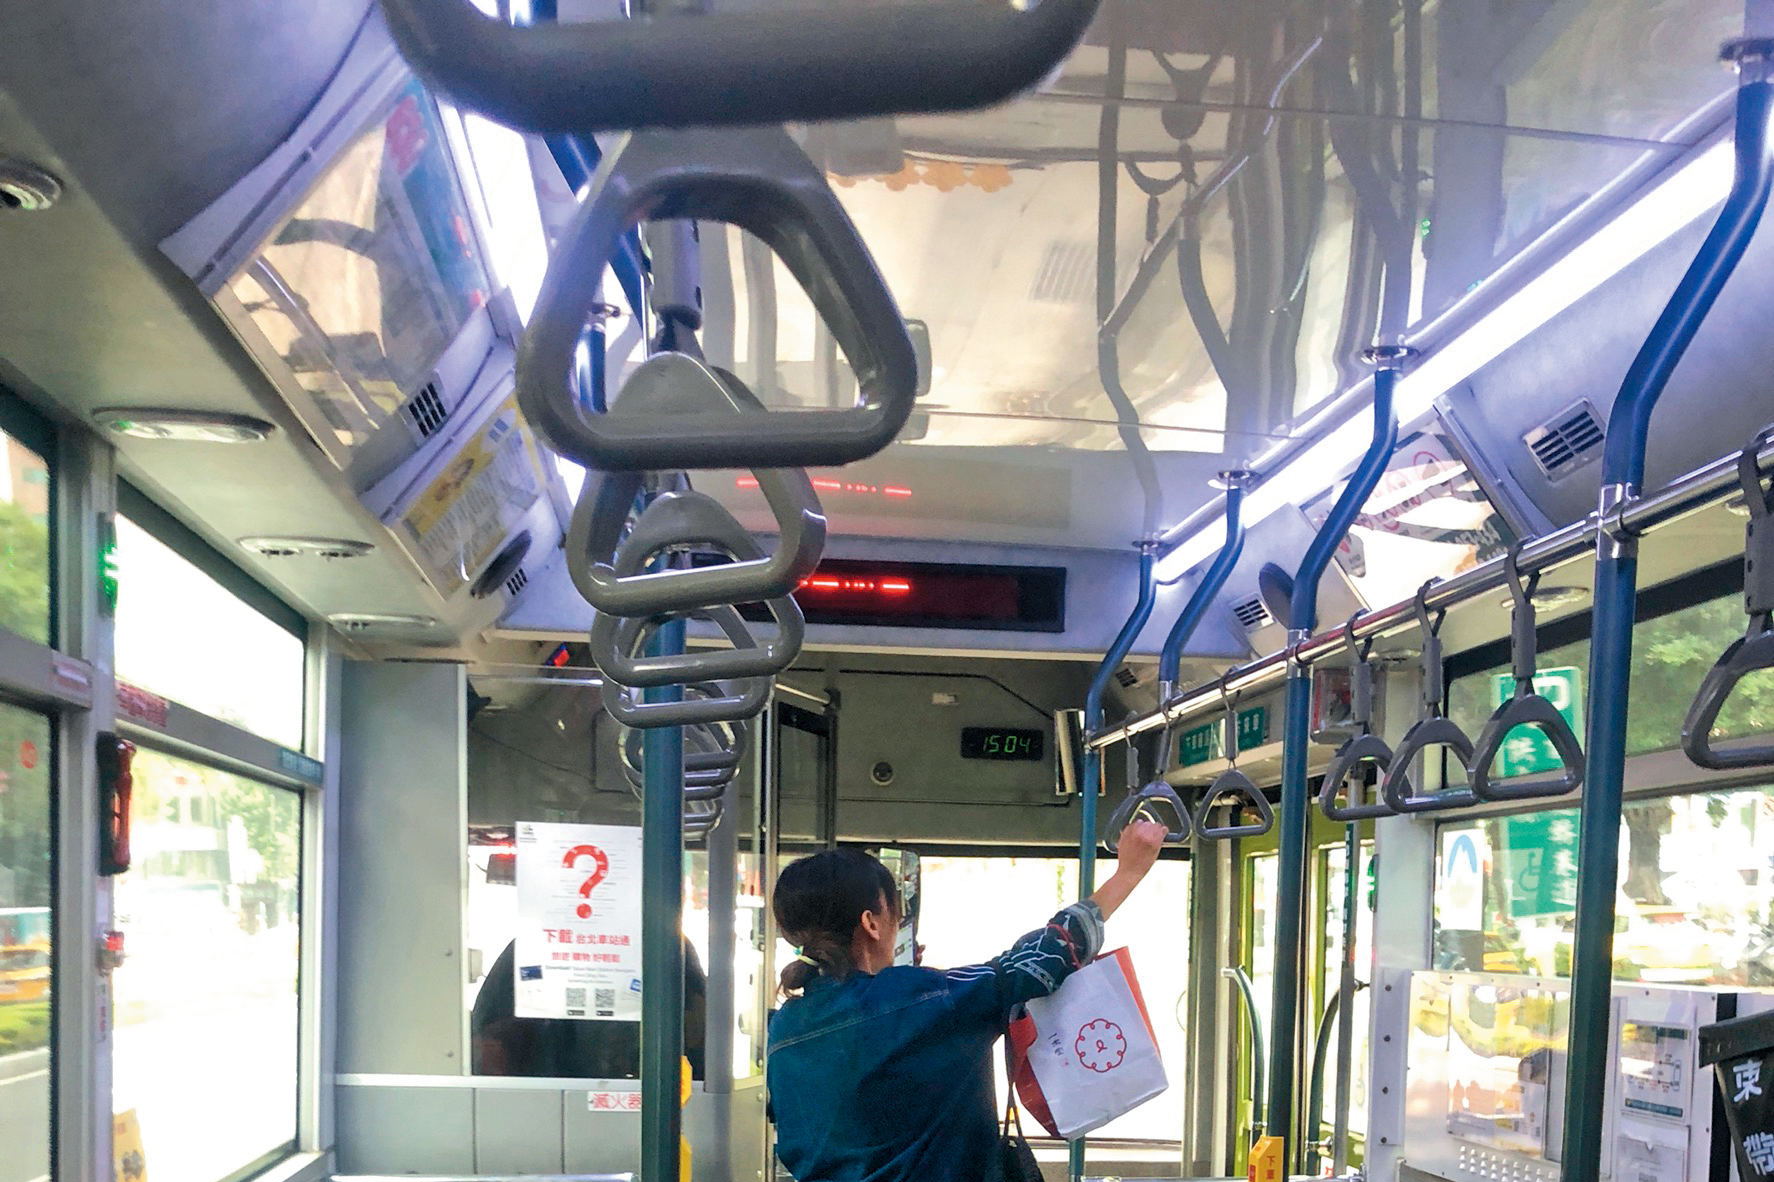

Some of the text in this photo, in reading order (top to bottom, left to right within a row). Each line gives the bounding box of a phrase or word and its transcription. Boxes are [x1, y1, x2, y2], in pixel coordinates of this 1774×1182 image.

[983, 735, 1031, 753] 1504
[543, 929, 573, 943] 下載
[593, 1093, 641, 1110] 滅火器
